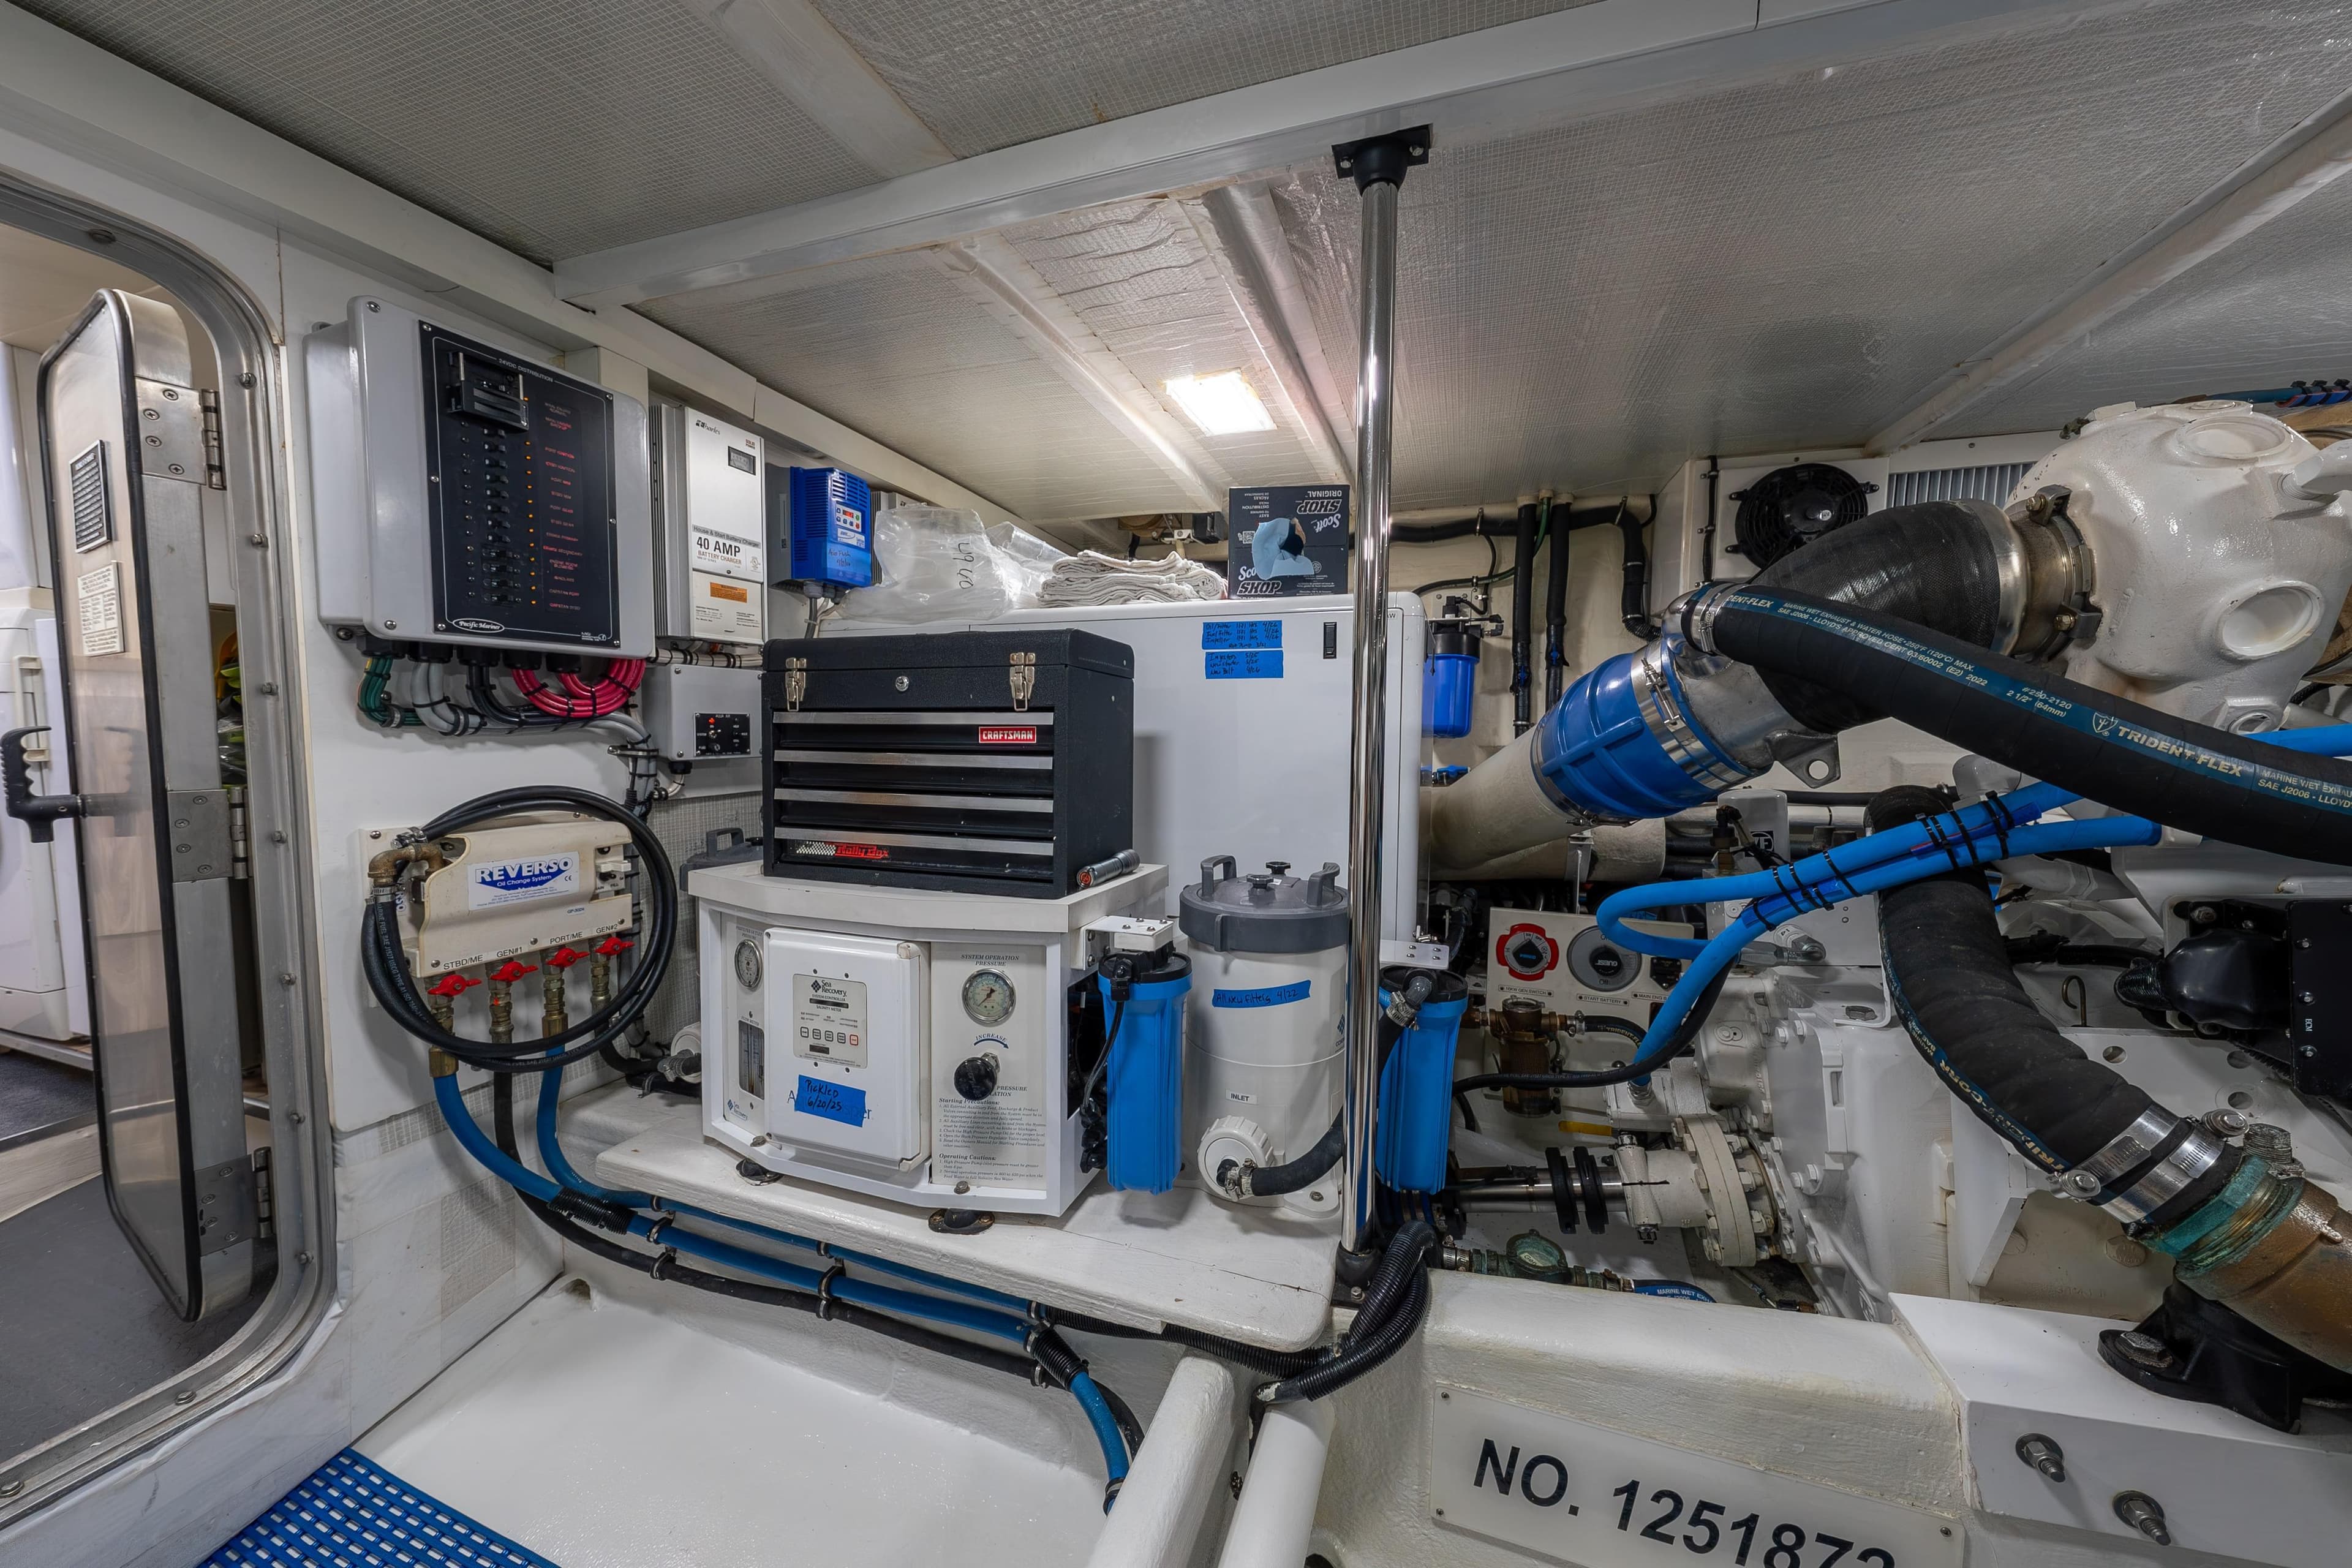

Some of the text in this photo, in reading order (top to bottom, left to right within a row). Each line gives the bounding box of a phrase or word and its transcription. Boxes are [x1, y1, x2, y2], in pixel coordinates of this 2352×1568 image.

[1297, 499, 1343, 514] SHOP
[1315, 513, 1341, 533] Scott
[696, 537, 741, 557] 40 AMP
[698, 550, 720, 560] BATTERY
[720, 555, 742, 565] CHARGER
[1237, 581, 1282, 595] SHOP
[1783, 602, 1807, 612] MARINE
[1820, 609, 1850, 625] EXHAUST
[1857, 622, 1882, 635] WATER
[1882, 631, 1903, 644] HOSE
[1954, 660, 1975, 672] MAX.
[1790, 611, 1808, 620] J2006
[1842, 626, 1883, 645] APPROVED
[1883, 641, 1908, 654] CERT
[1946, 665, 1964, 677] (E2)
[1966, 674, 1988, 687] 2022
[2021, 686, 2072, 710] #250-2120
[2035, 699, 2067, 718] (64mm)
[982, 730, 1033, 740] CRAFTSMAN
[2262, 769, 2299, 785] MARINE
[2300, 779, 2321, 791] WET
[2258, 778, 2280, 791] SAE
[2281, 785, 2311, 799] J2006
[475, 858, 573, 883] REVERSO
[507, 878, 530, 886] Change
[532, 875, 552, 884] System
[596, 924, 618, 934] GEN#2
[550, 932, 583, 944] PORT/ME
[497, 946, 523, 957] GEN#1
[443, 954, 484, 970] STBD/ME
[822, 986, 847, 997] Recovery
[1276, 989, 1299, 1001] 4/22
[976, 1033, 1008, 1042] INCREASE
[808, 1095, 843, 1113] 6/20/25
[1231, 1093, 1250, 1101] INLET
[1472, 1438, 1580, 1517] NO.
